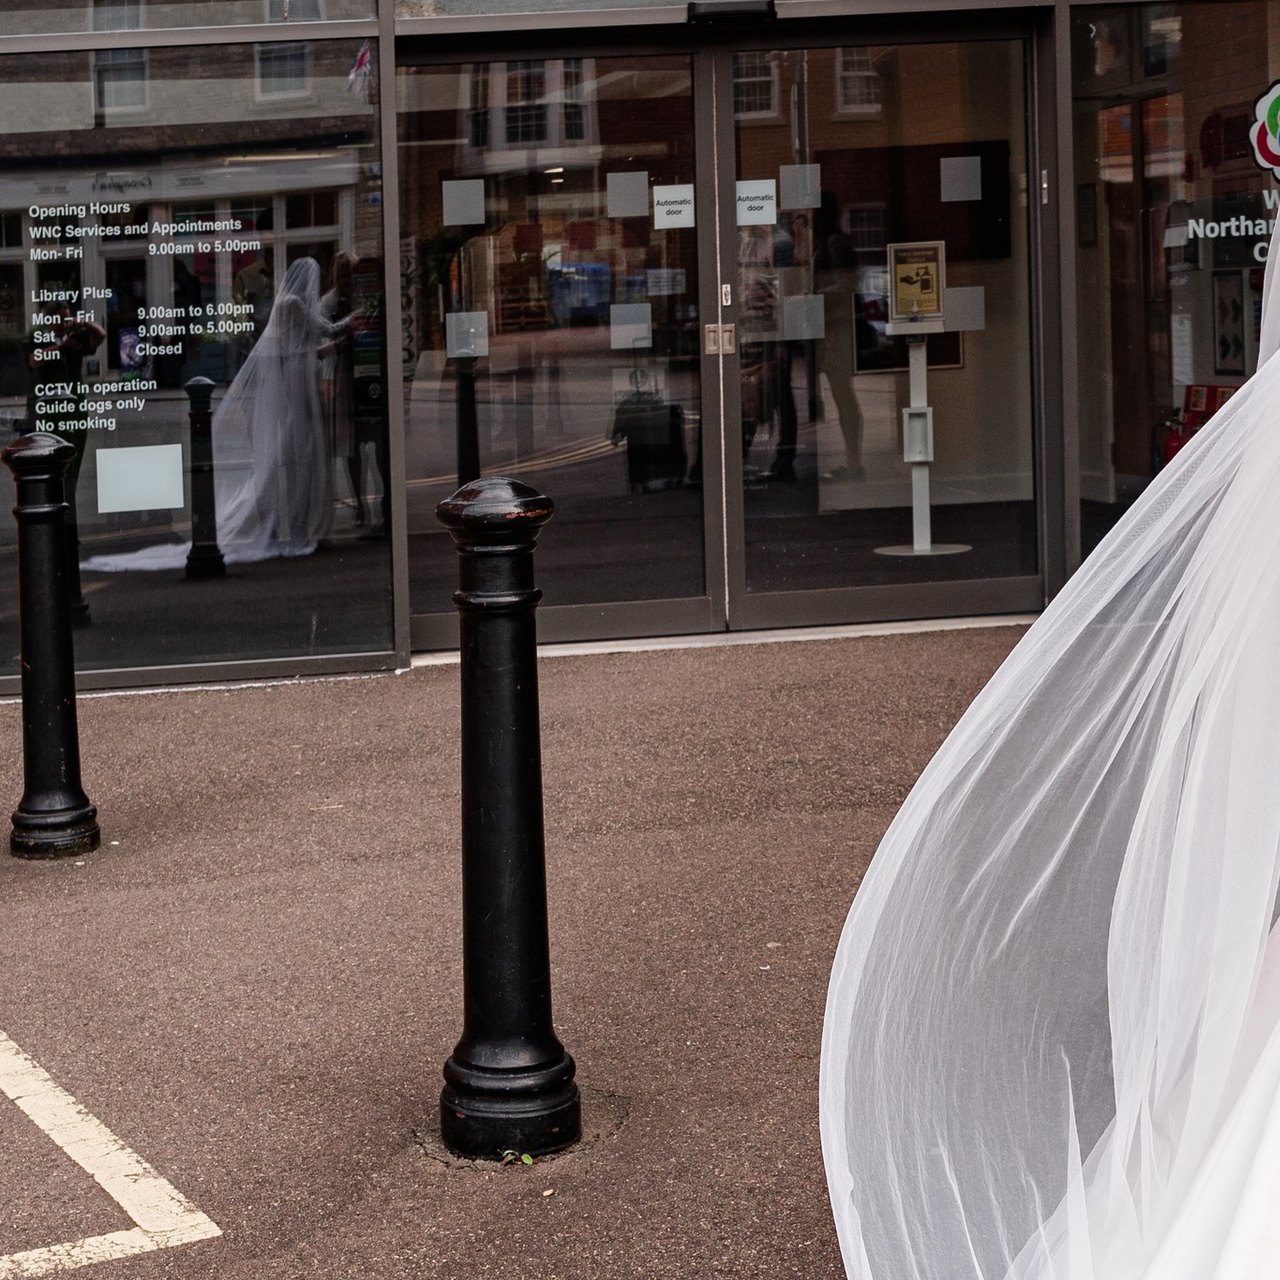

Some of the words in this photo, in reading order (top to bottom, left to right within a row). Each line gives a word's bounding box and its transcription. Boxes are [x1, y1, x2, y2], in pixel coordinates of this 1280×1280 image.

[656, 198, 692, 207] Automatic
[736, 194, 774, 202] Automatic
[29, 204, 86, 220] Opening
[90, 202, 131, 215] Hours
[665, 208, 683, 216] door
[746, 204, 765, 212] door
[29, 226, 62, 239] WNC
[65, 224, 121, 238] Services
[124, 222, 149, 235] and
[151, 219, 242, 235] Appointments
[66, 246, 83, 259] Fri
[148, 243, 195, 256] 9.00am
[197, 242, 211, 253] to
[214, 239, 261, 254] 5.00pm
[31, 289, 79, 304] Library
[83, 286, 113, 300] Plus
[32, 312, 61, 326] Mon
[76, 310, 95, 323] Fri
[137, 307, 185, 320] 9.00am
[188, 305, 202, 317] to
[206, 303, 254, 317] 6.00pm
[34, 330, 55, 343] Sat
[138, 324, 186, 337] 9.00am
[189, 322, 202, 334] to
[206, 320, 255, 334] 5.00pm
[34, 348, 60, 361] Sun
[136, 342, 183, 357] Closed
[35, 382, 73, 397] CCTV
[77, 382, 90, 394] in
[93, 379, 158, 394] operation
[35, 400, 76, 414] Guide
[79, 398, 113, 414] dogs
[116, 396, 146, 411] only
[35, 419, 55, 432] No
[58, 416, 116, 432] smoking
